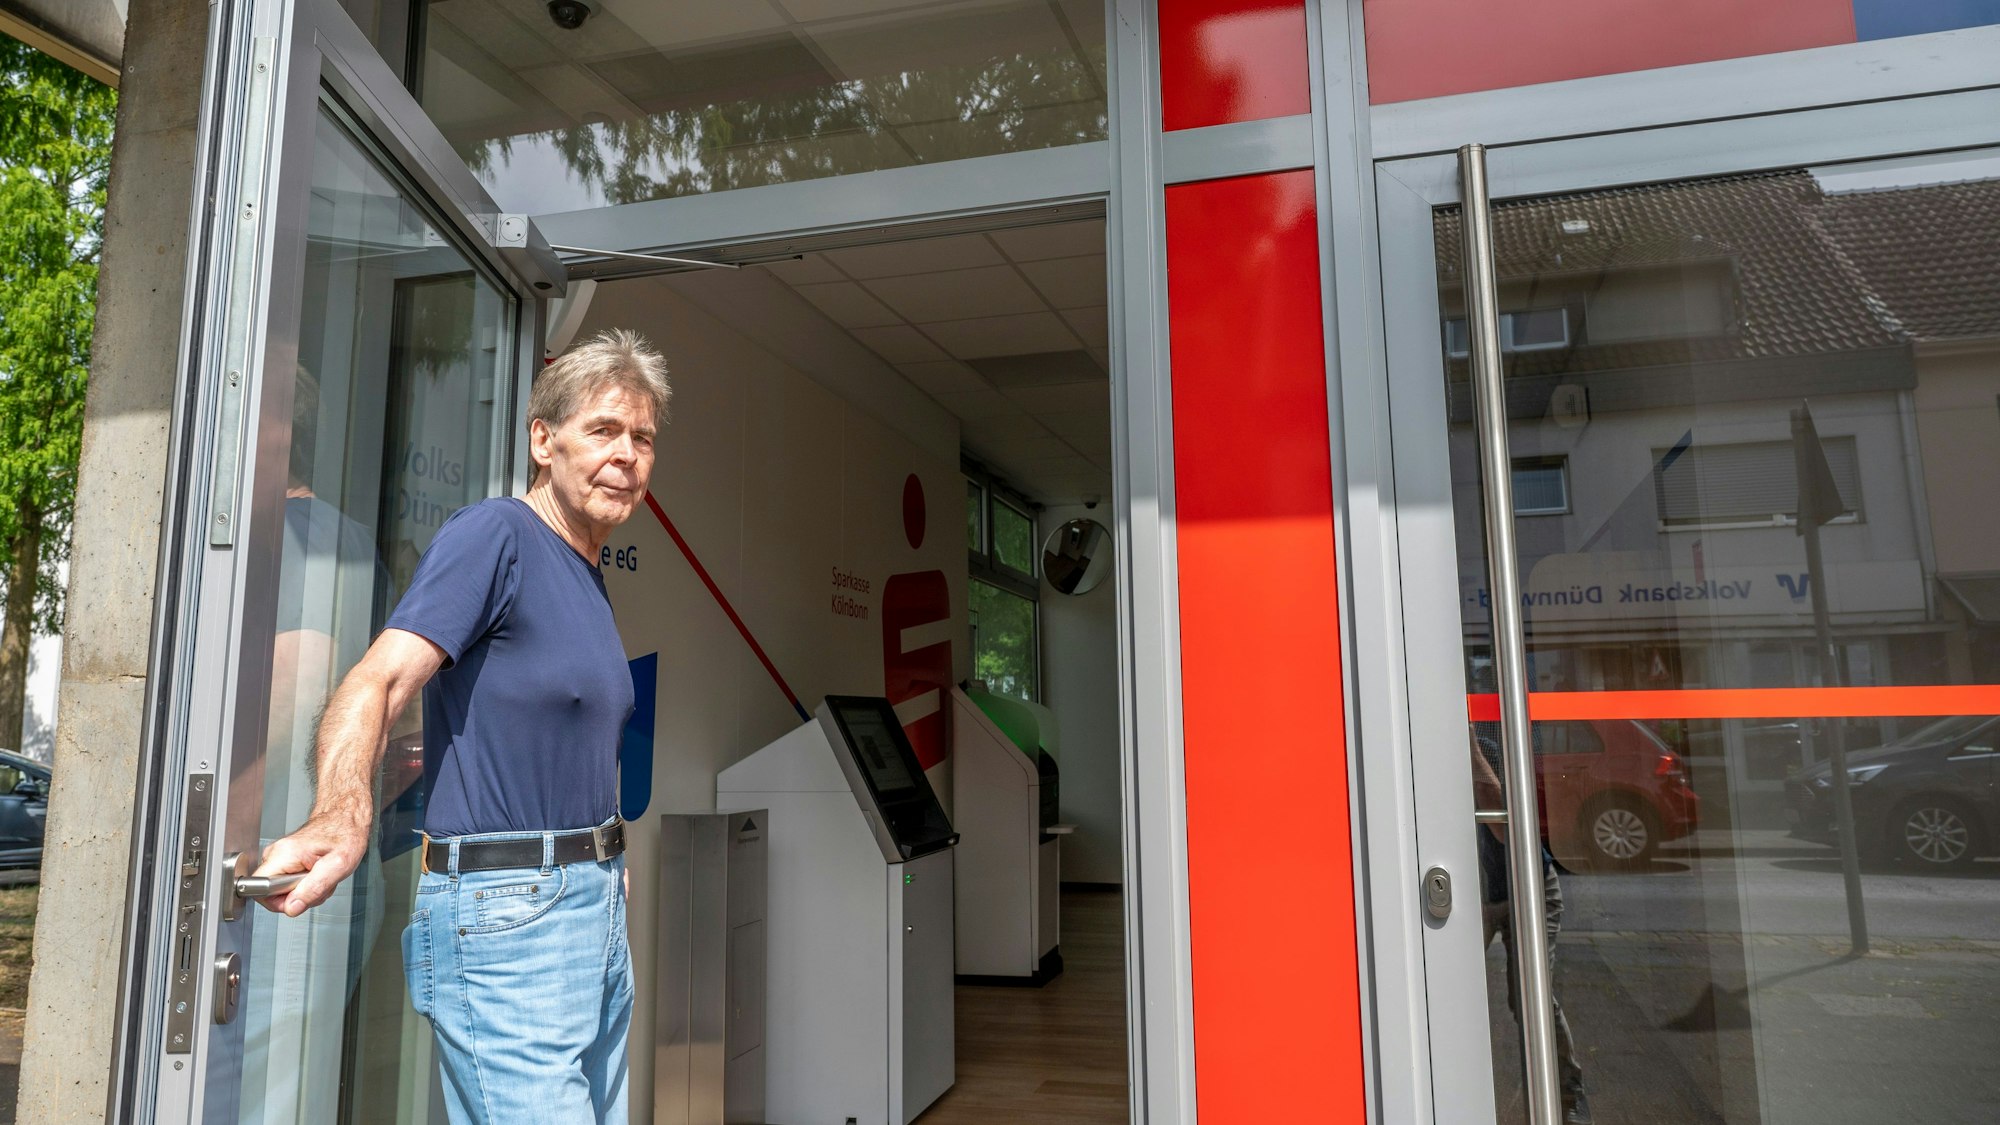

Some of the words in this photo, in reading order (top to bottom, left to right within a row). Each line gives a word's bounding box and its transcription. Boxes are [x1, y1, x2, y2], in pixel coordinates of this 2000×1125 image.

[616, 545, 637, 572] eG
[832, 566, 870, 594] Sparkasse
[831, 593, 869, 620] KölnBonn
